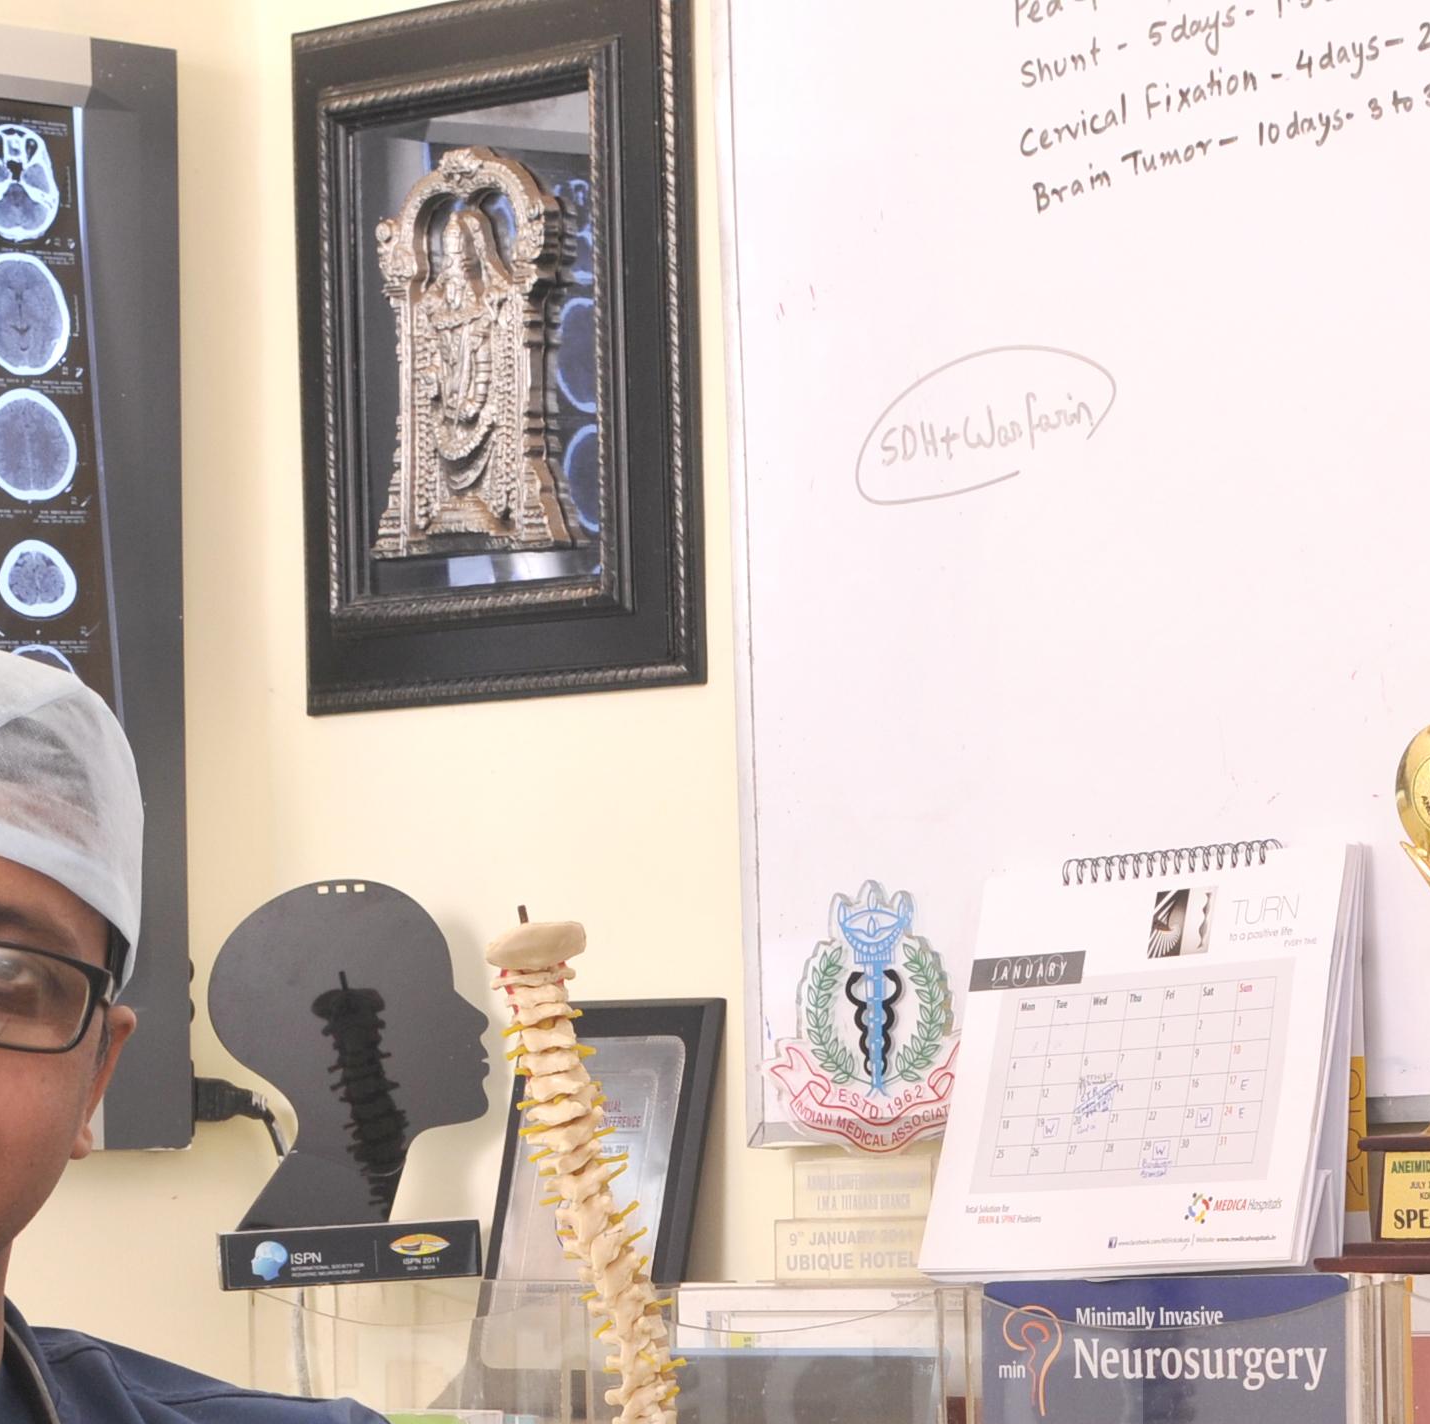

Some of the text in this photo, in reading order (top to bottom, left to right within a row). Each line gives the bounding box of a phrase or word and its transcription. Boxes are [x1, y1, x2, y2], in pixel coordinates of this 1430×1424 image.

[1021, 36, 1101, 88] Shunt
[1020, 93, 1126, 156] Cervical
[1145, 66, 1257, 120] Fixation
[1033, 163, 1111, 214] Brain
[1121, 139, 1212, 175] Tumor
[1392, 90, 1413, 113] to
[1232, 895, 1300, 925] TURN
[1229, 926, 1293, 943] to positive life
[991, 961, 1068, 982] JANUARY
[1021, 983, 1253, 1011] Mon Tue Wed Thu Fri Sat Sun
[1233, 1045, 1241, 1054] 10
[1007, 1075, 1237, 1100] 11 12 14 15 16 17
[887, 1085, 924, 1116] 1962
[794, 1100, 833, 1126] INDIAN
[836, 1115, 888, 1147] MEDICAL
[1002, 1106, 1233, 1129] 18 19 20 21 22 23 24
[996, 1136, 1227, 1159] 25 26 27 28 29 30 31
[1409, 1181, 1426, 1189] JULY
[1213, 1197, 1282, 1213] MEDICA Hospitals
[809, 1230, 875, 1246] JANUARY
[291, 1252, 321, 1265] ISPN
[403, 1256, 440, 1265] ISPN 2011
[786, 1251, 918, 1271] UBIQUE HOTEL
[1075, 1306, 1224, 1330] Minimally Invasive
[998, 1360, 1026, 1379] min
[1073, 1337, 1328, 1392] Neurosurgery
